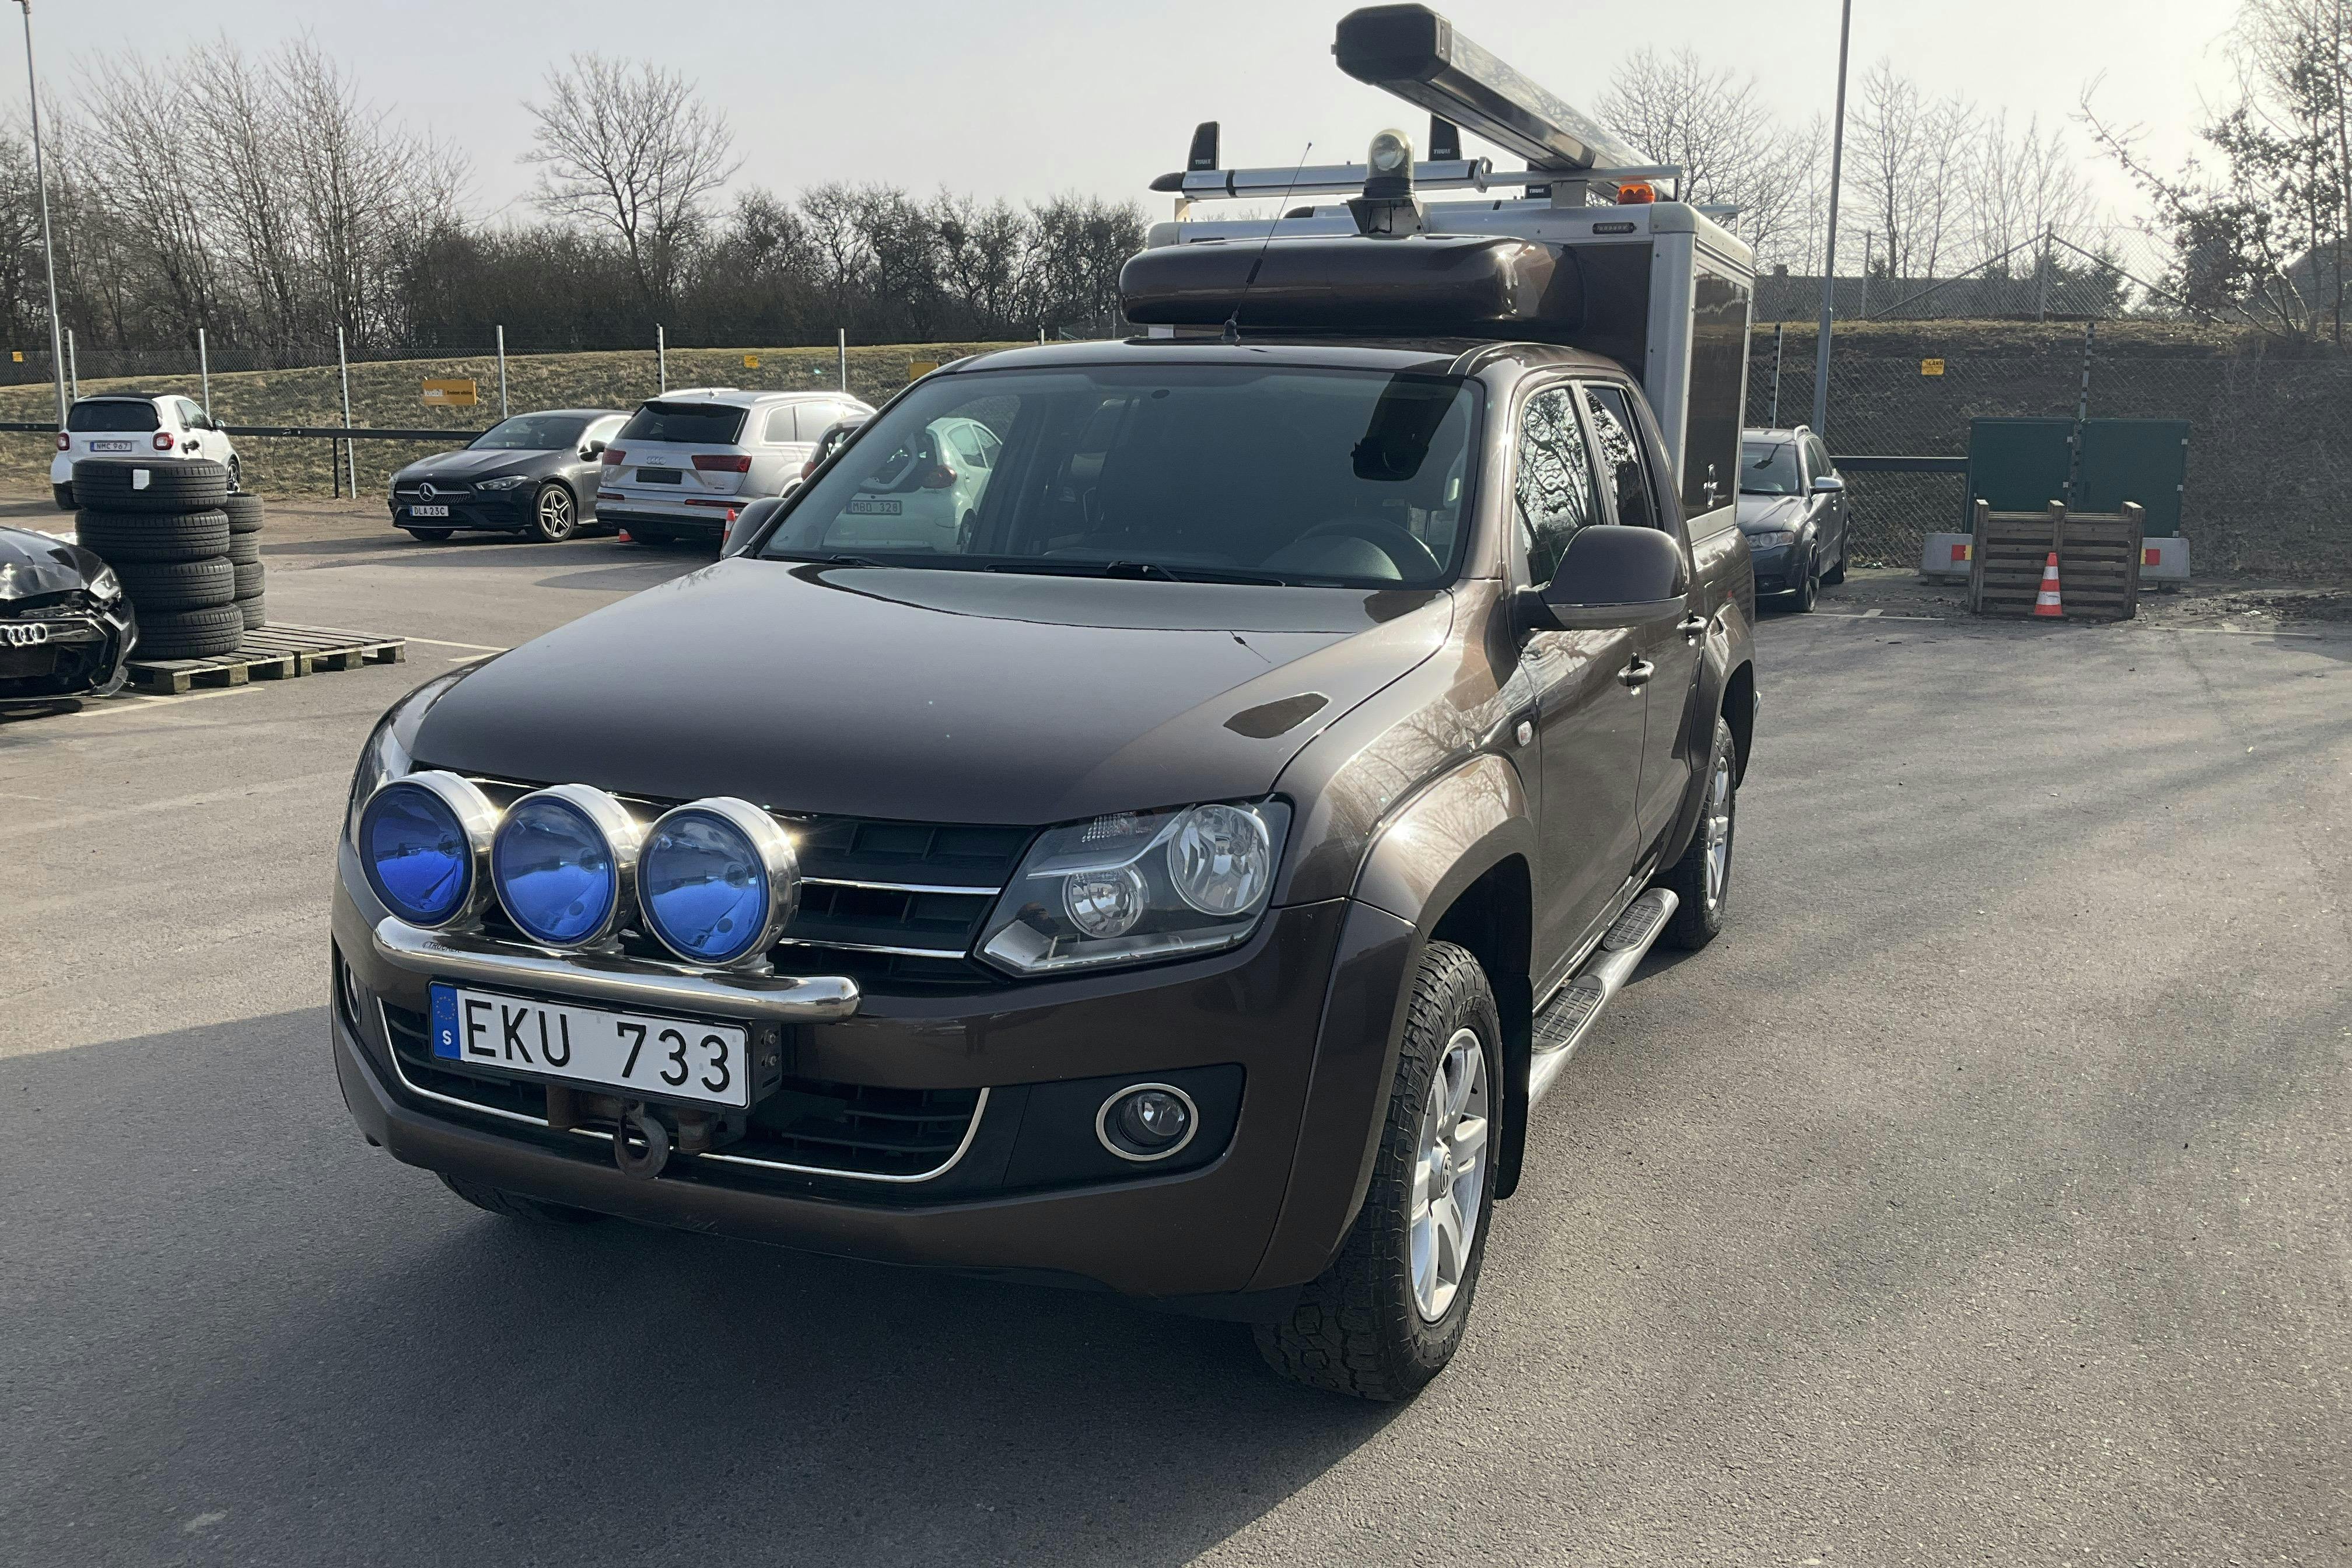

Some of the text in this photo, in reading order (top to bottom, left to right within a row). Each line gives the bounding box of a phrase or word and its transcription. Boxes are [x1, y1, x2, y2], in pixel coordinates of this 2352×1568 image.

[429, 507, 445, 515] 23C
[879, 502, 898, 512] 328
[442, 1030, 452, 1045] S
[465, 998, 730, 1093] EKU 733
